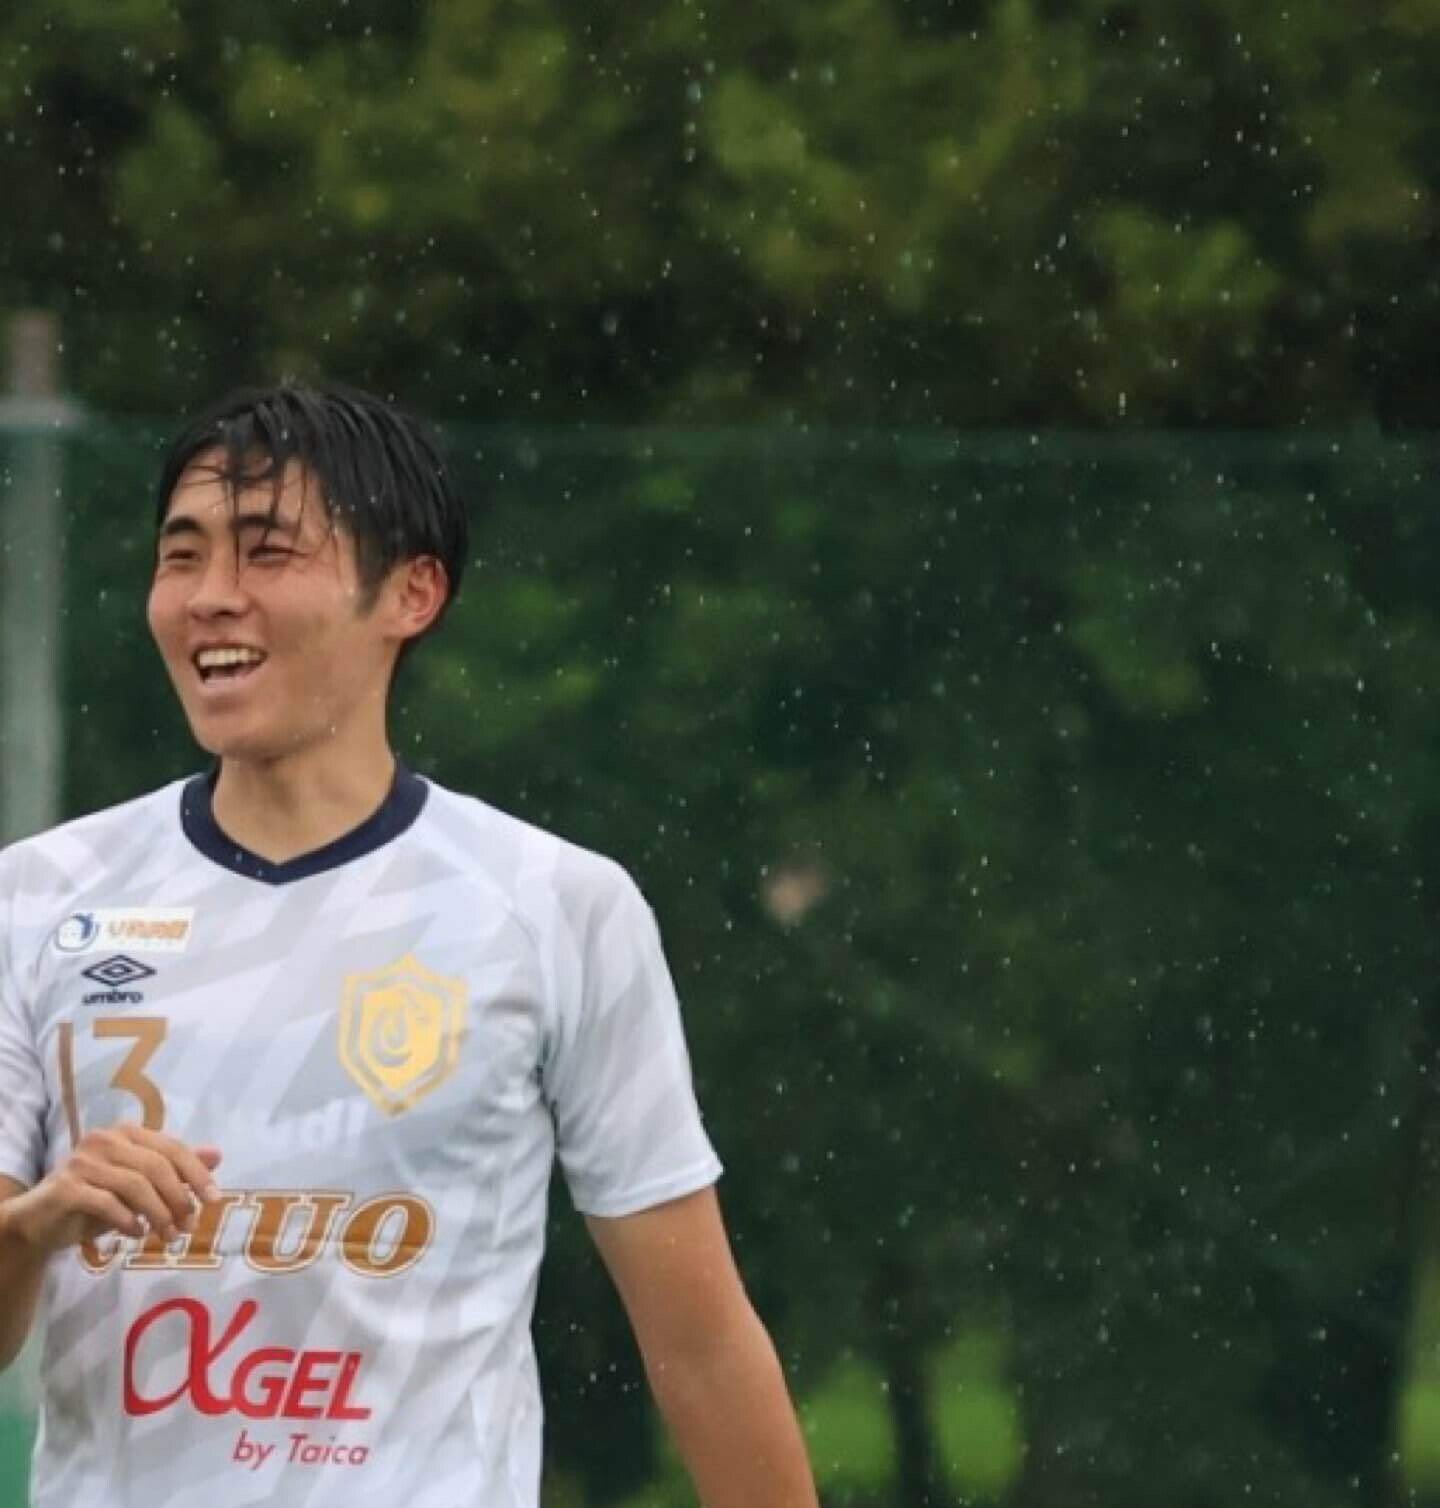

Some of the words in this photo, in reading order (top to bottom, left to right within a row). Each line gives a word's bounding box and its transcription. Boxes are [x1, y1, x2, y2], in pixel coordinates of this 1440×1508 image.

[58, 1017, 168, 1152] 13
[233, 1430, 275, 1471] by
[288, 1432, 370, 1466] Taica
